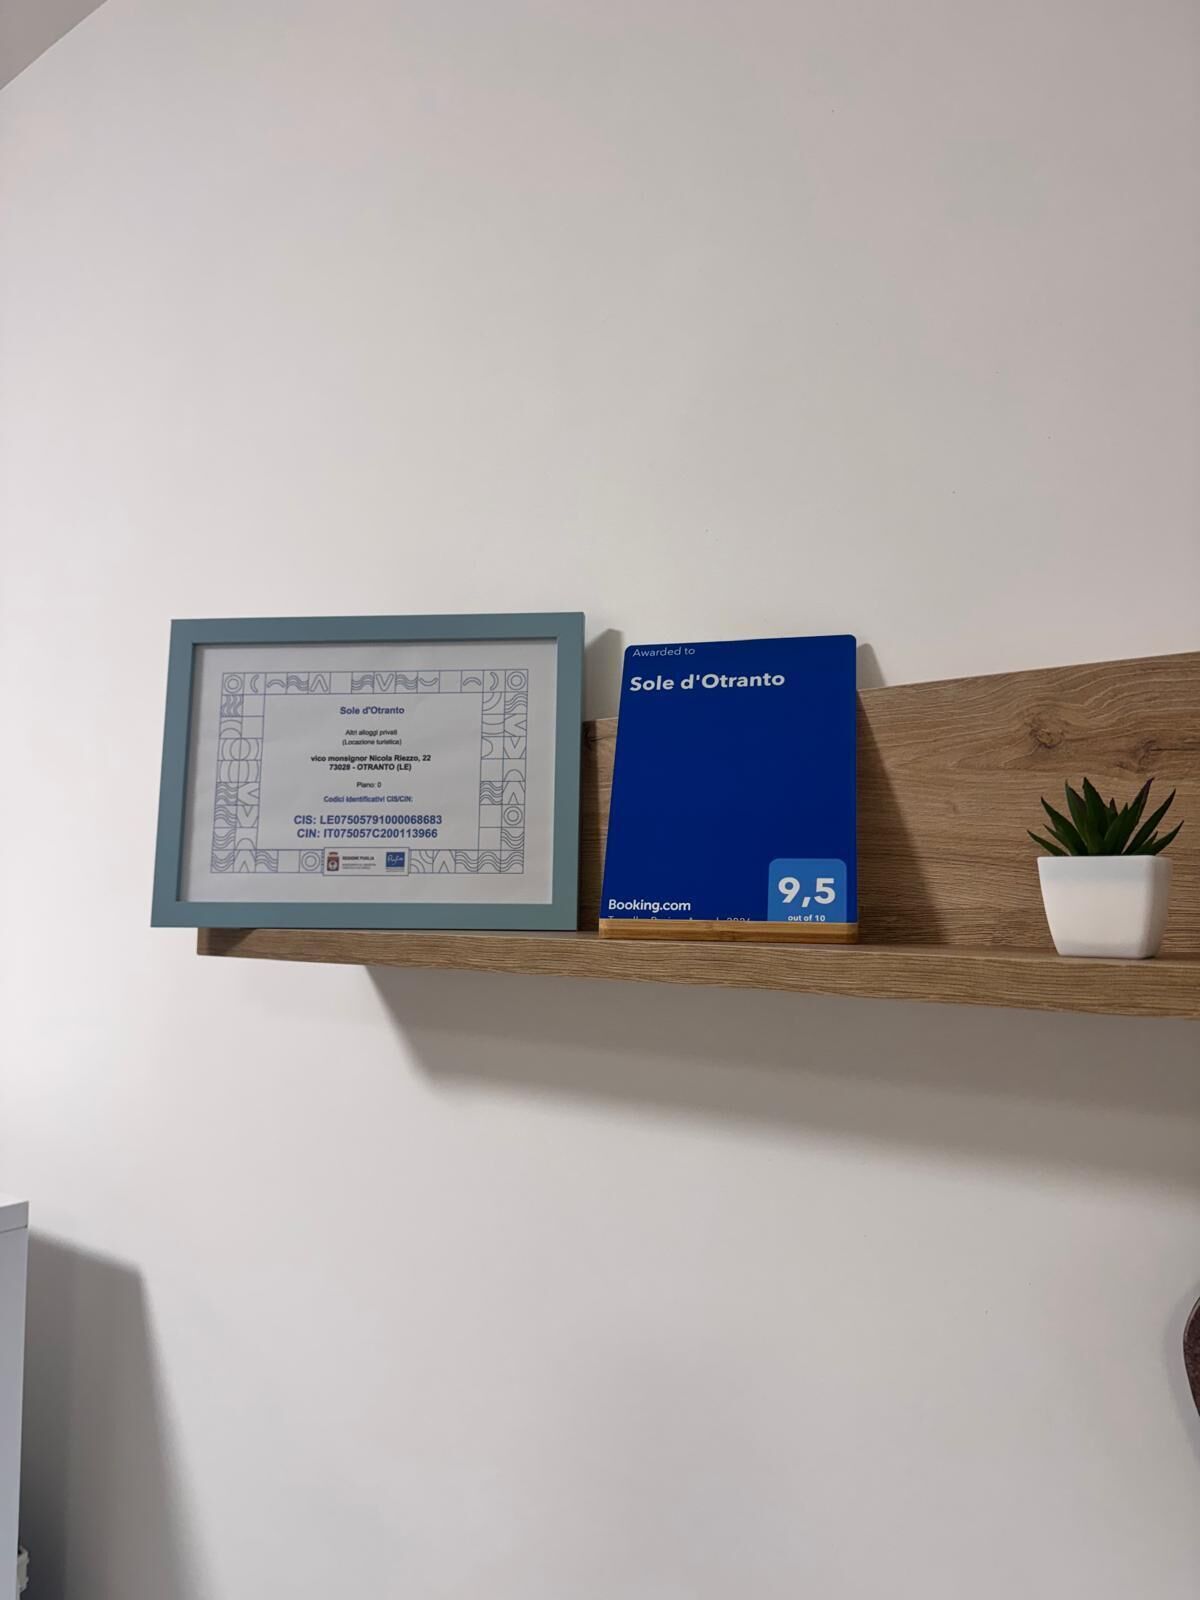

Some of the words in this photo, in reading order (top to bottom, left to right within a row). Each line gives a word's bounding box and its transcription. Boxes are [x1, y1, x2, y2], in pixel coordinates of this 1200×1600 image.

[632, 646, 682, 658] Awarded
[684, 646, 696, 656] to
[629, 674, 675, 692] Sole
[680, 672, 786, 690] d'Otranto
[340, 706, 360, 715] Sole
[362, 706, 405, 715] d'Otranto
[359, 730, 379, 738] alloggi
[380, 730, 398, 738] privati
[328, 755, 368, 763] monsignor
[323, 795, 344, 803] Codici
[293, 815, 317, 825] CIS:
[319, 815, 443, 825] LE07505791000068683
[297, 829, 320, 839] CIN:
[323, 829, 438, 839] IT075057C200113966
[778, 876, 836, 908] 9,5
[608, 899, 692, 913] Booking.com
[803, 914, 813, 922] of
